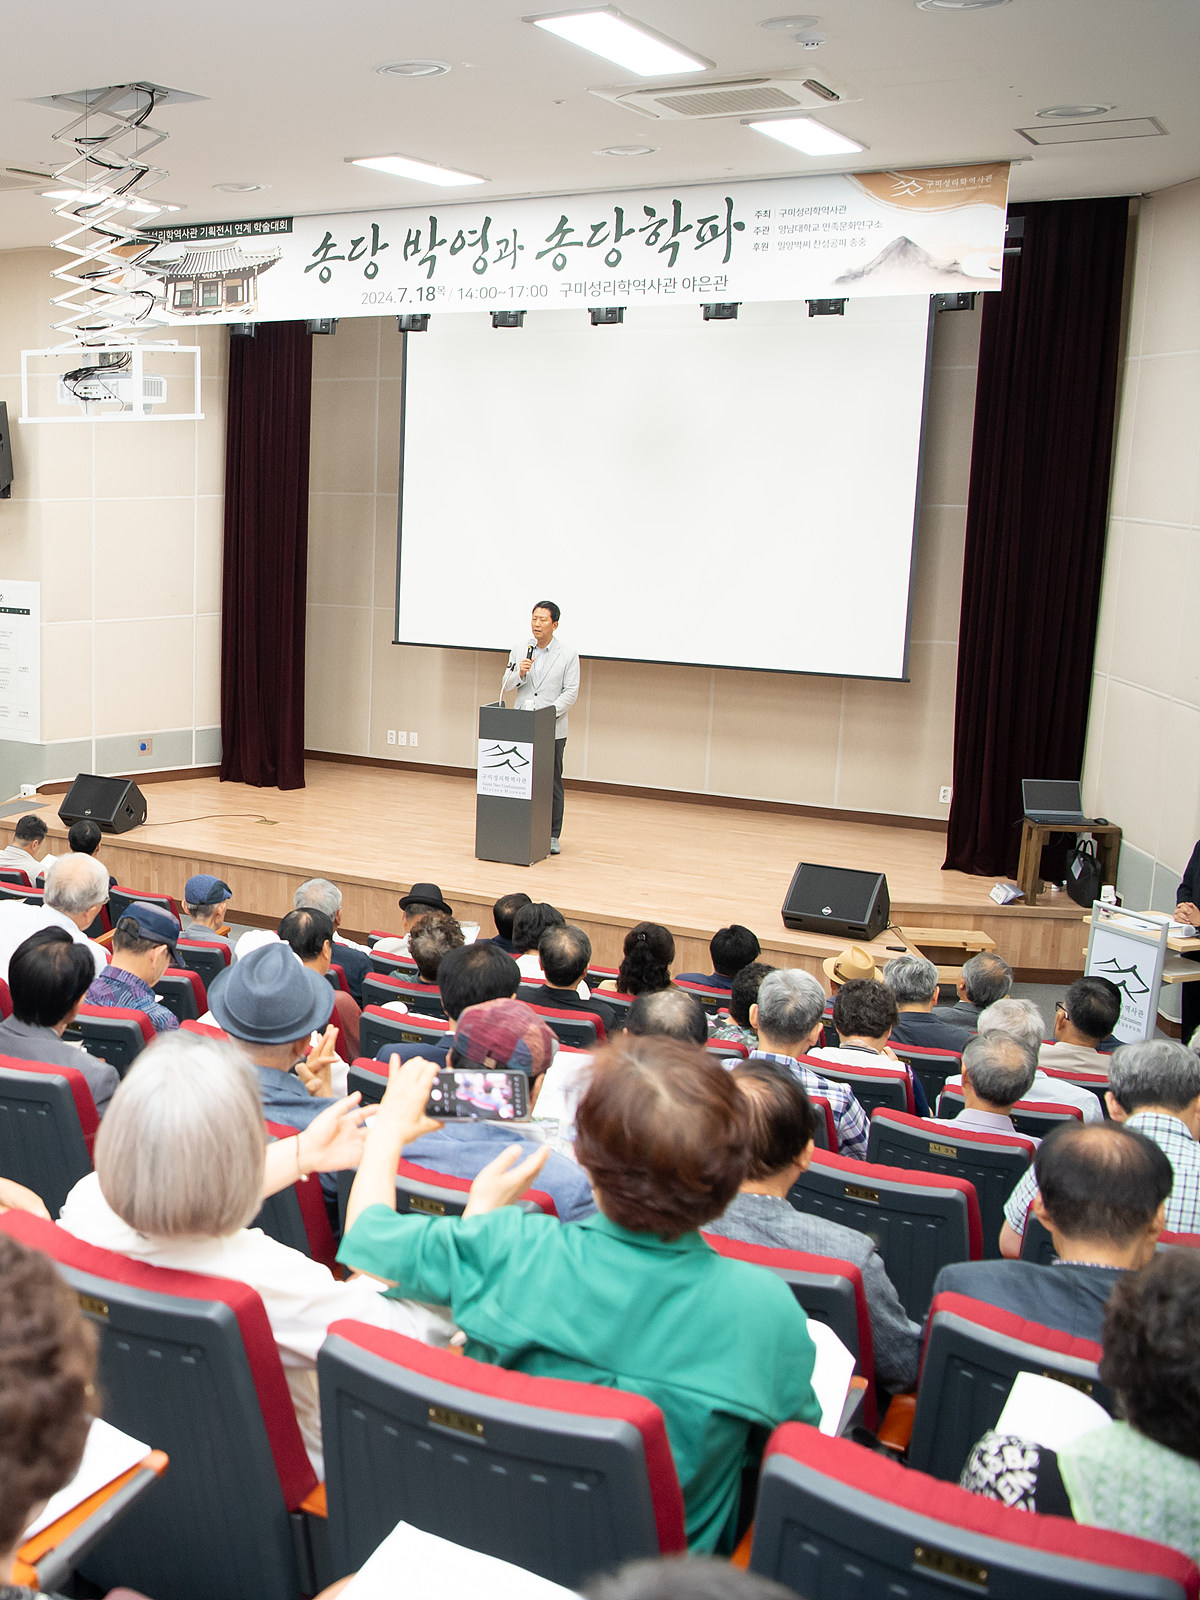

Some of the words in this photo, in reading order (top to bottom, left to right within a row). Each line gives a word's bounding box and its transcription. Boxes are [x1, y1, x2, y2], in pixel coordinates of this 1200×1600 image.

[754, 209, 772, 219] 주최
[779, 204, 847, 218] 구미성리학역사관
[200, 224, 233, 237] 기획전시
[234, 222, 252, 235] 연계
[253, 219, 288, 232] 학술대회
[753, 225, 770, 236] 주관
[778, 223, 820, 235] 영남대학교
[303, 222, 390, 284] 송당
[403, 215, 525, 280] 박영과
[535, 196, 746, 272] 송당학파
[752, 241, 769, 252] 후원
[458, 284, 549, 300] 14:00~17:00
[559, 276, 678, 298] 구미성리학역사관
[681, 274, 729, 294] 야은관
